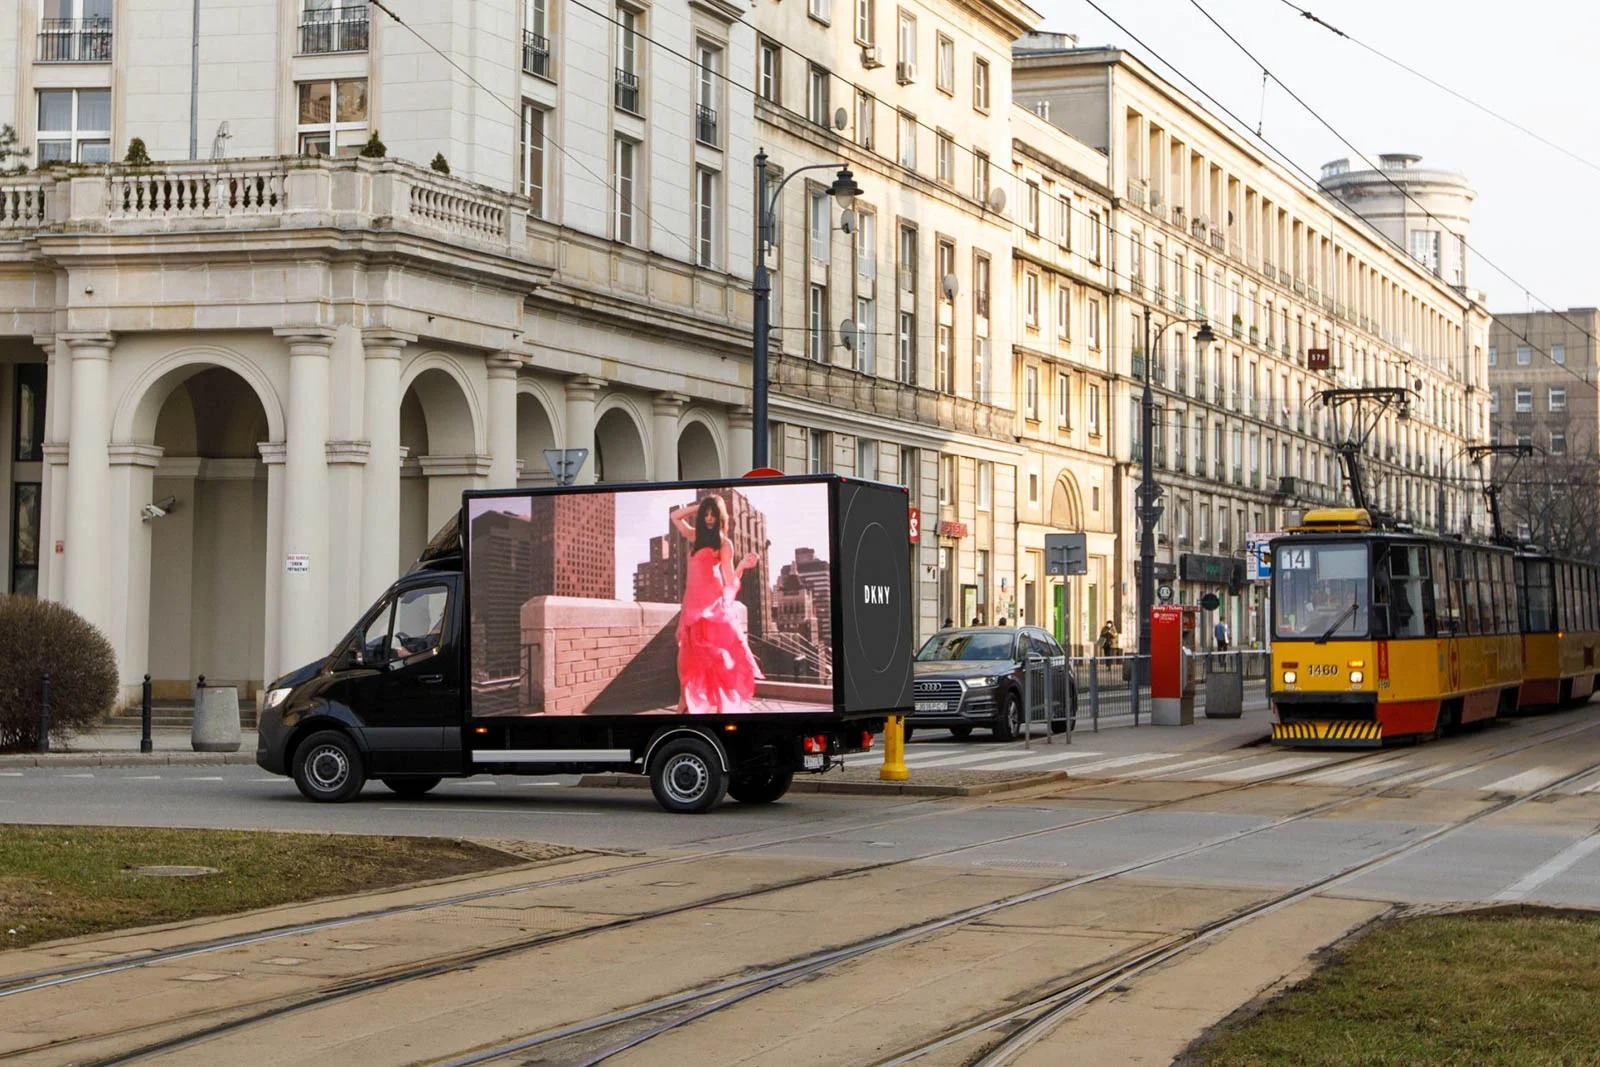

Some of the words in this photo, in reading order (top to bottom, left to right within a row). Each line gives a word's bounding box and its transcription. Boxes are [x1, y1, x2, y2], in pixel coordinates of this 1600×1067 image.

[1286, 549, 1305, 569] 14
[864, 584, 890, 604] DKNY
[1308, 664, 1338, 677] 1460
